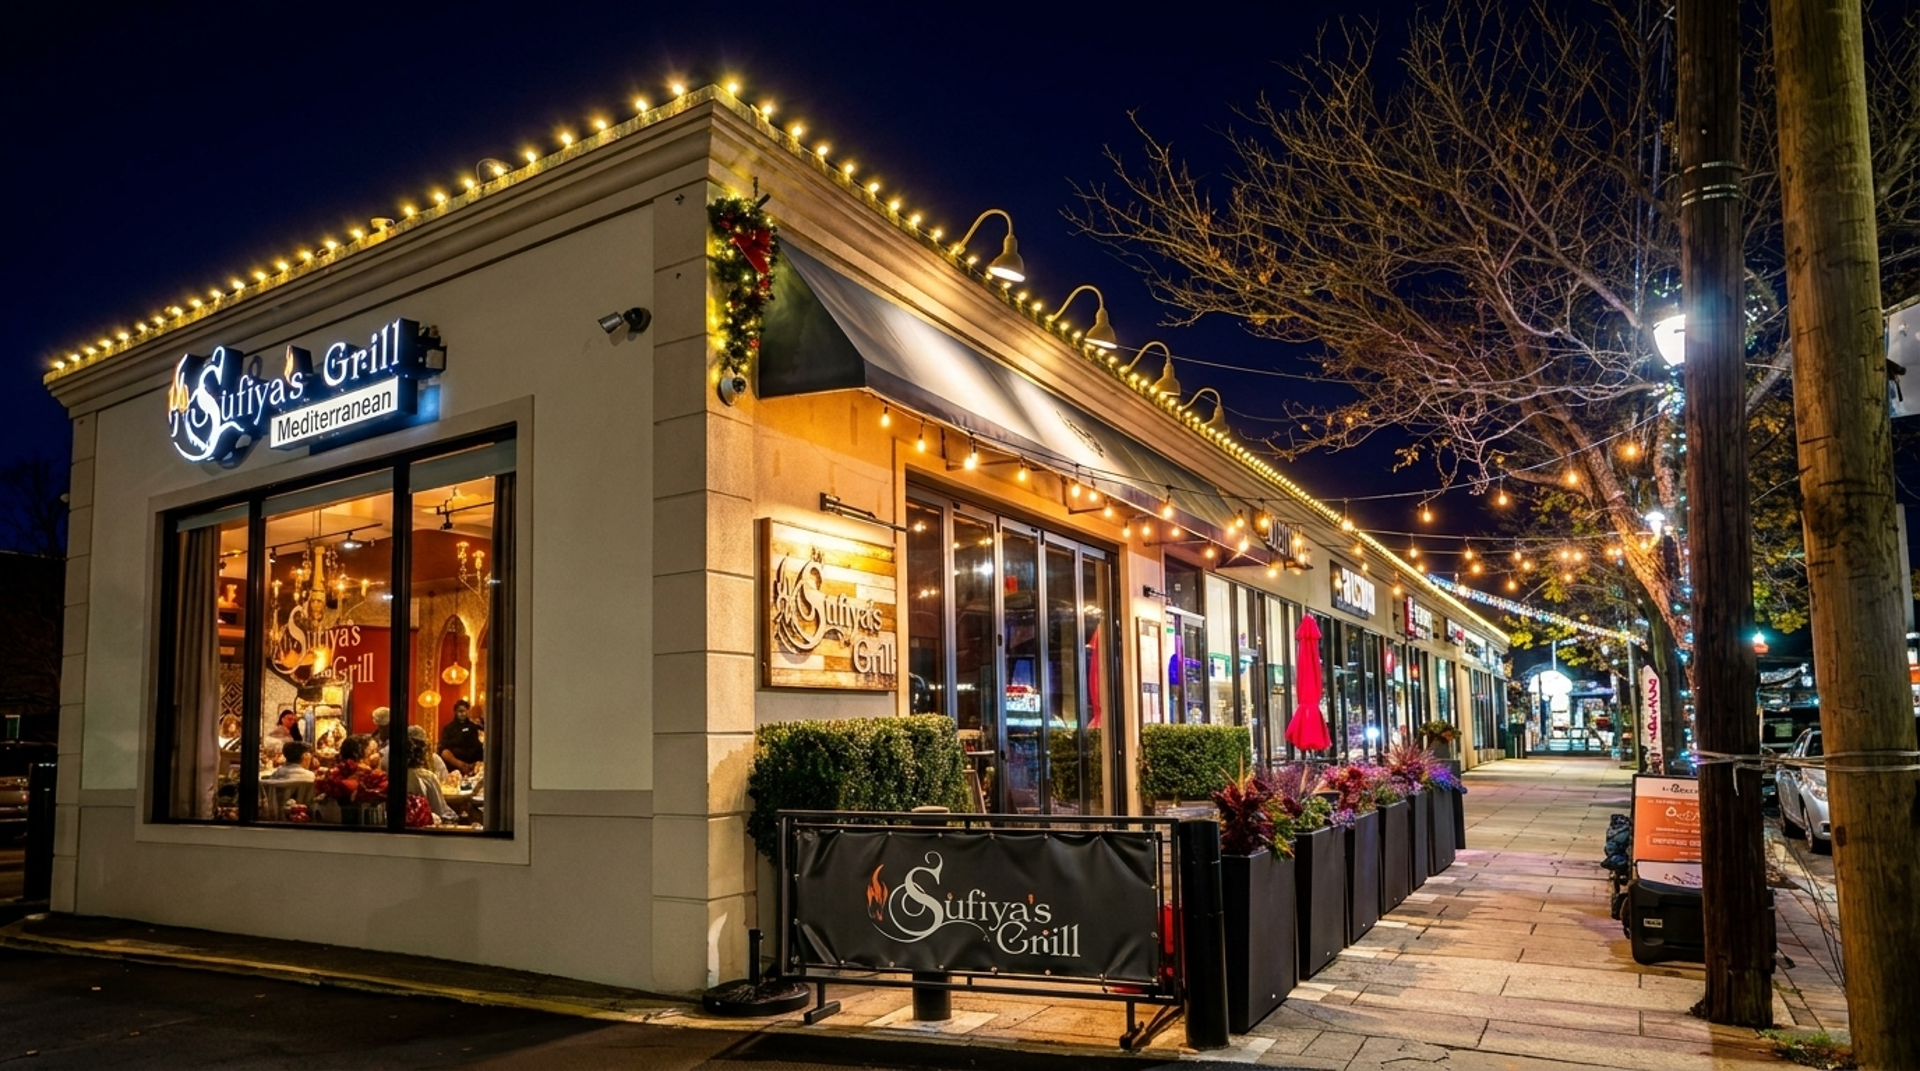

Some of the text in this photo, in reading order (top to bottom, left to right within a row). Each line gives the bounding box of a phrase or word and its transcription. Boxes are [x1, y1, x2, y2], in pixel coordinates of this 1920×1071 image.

[172, 318, 400, 462] Sufiya's Grill
[277, 389, 391, 442] Mediterranean
[778, 560, 883, 655] Sufiya's
[332, 652, 374, 685] Grill
[853, 637, 897, 675] Grill
[872, 851, 1052, 943] Sufiya's
[996, 922, 1081, 958] Grill
